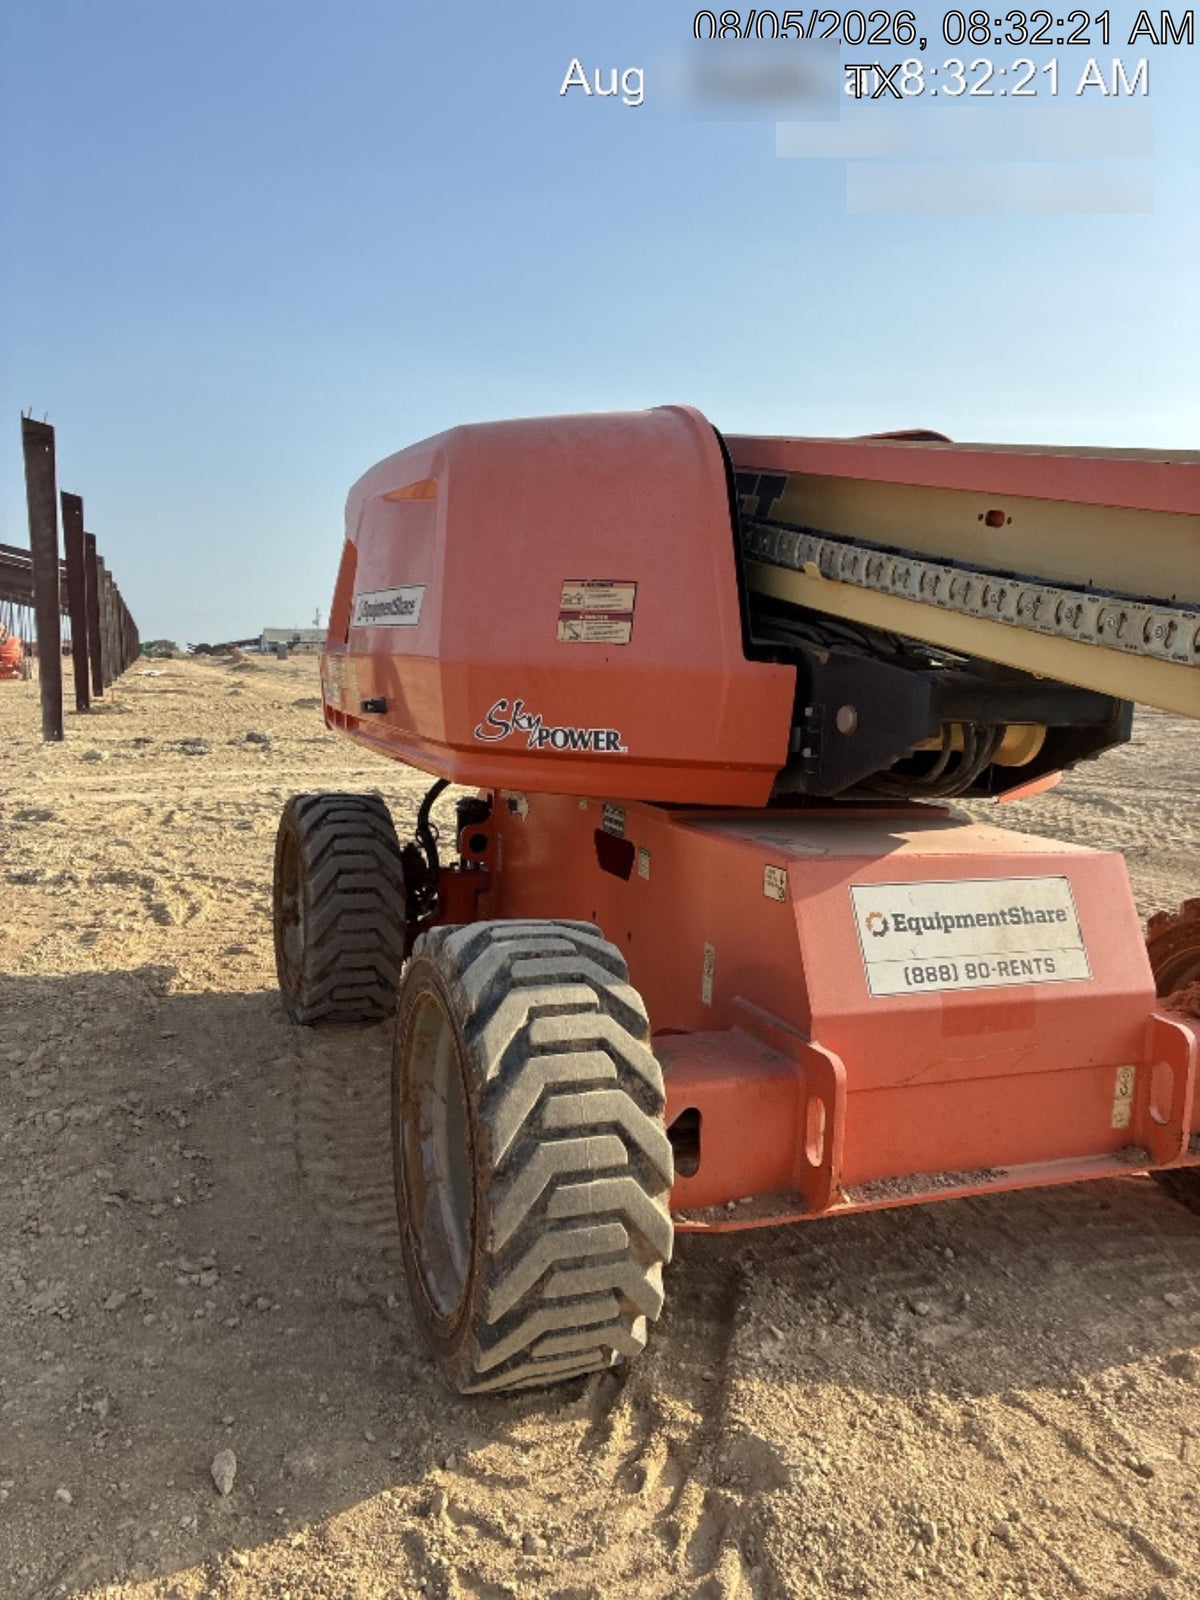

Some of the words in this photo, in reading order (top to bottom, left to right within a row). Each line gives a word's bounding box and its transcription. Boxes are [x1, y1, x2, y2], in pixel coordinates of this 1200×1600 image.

[474, 698, 543, 748] Sky
[536, 726, 623, 752] POWER
[891, 906, 1067, 935] EquipmentShare
[904, 963, 958, 986] (888)
[965, 957, 1056, 980] 80-RENTS
